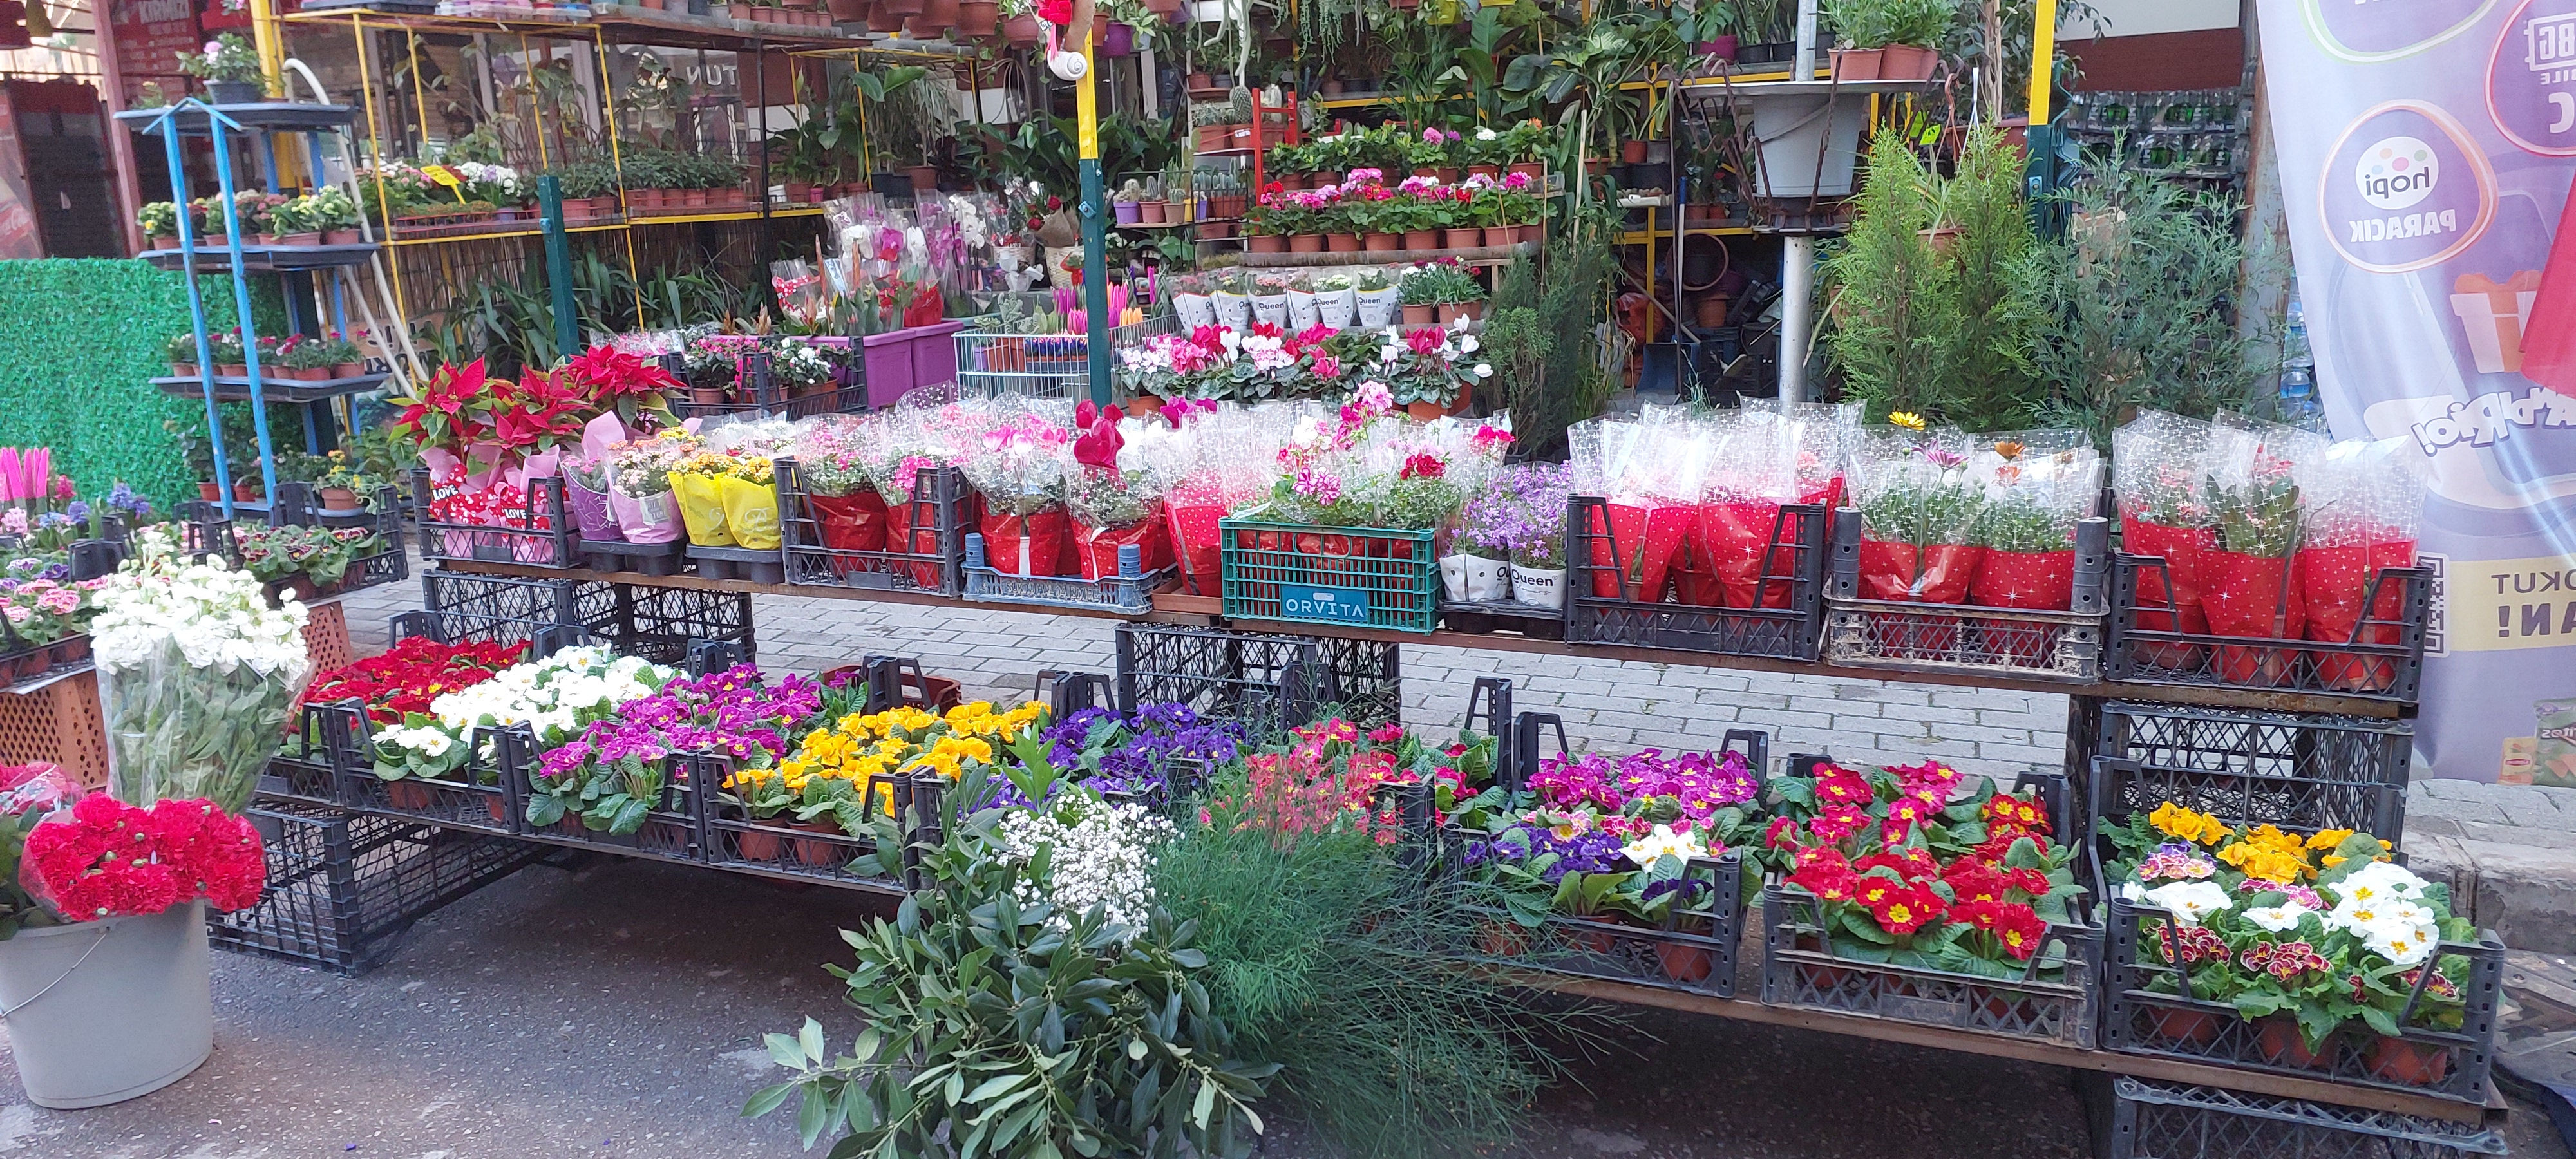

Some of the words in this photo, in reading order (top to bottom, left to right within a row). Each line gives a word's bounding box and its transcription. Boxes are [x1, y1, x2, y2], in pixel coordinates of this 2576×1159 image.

[1258, 302, 1284, 311] Queen
[1318, 298, 1339, 307] Queen
[1358, 297, 1381, 305] Queen
[432, 484, 459, 500] LOVE
[505, 509, 527, 520] LOVE
[1511, 569, 1553, 587] Queen
[1285, 598, 1365, 617] ORVITA
